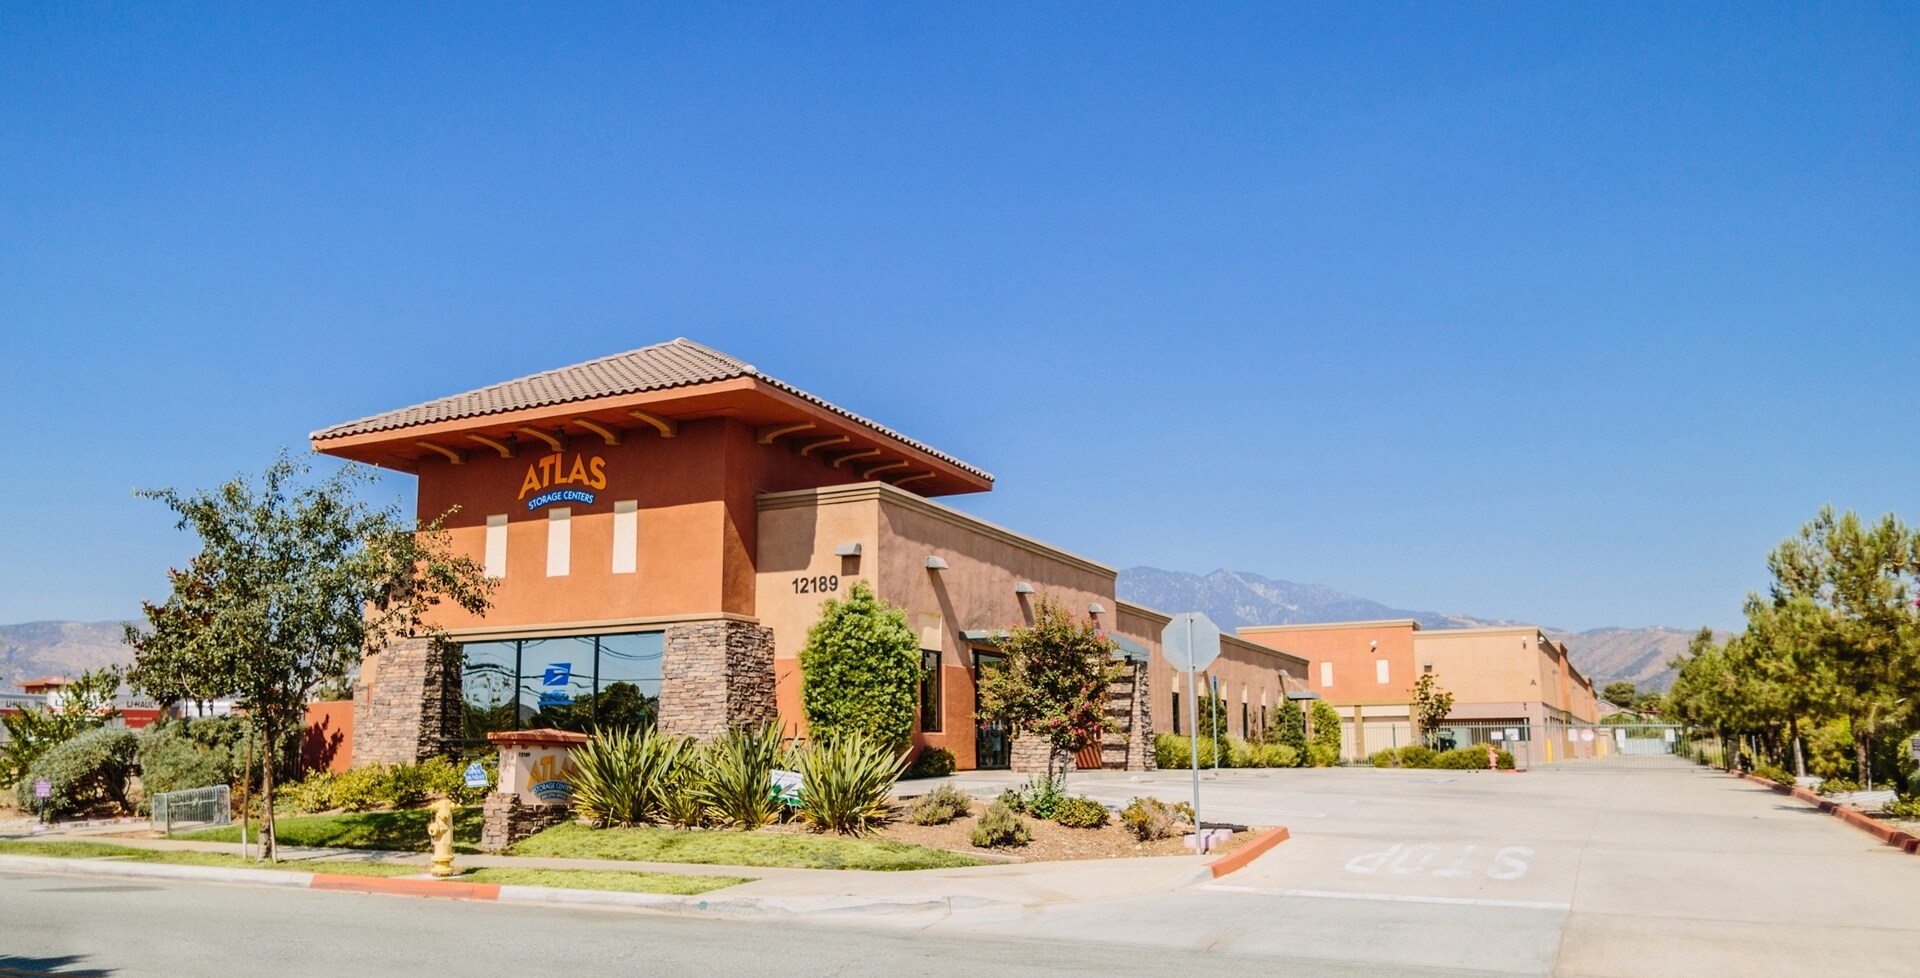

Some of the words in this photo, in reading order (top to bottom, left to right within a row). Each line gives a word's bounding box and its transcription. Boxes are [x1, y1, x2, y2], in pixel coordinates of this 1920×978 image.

[518, 453, 607, 500] ATLAS
[528, 491, 562, 510] STORAGE
[563, 490, 595, 504] CENTERS
[792, 575, 838, 594] 12189
[534, 782, 555, 794] STORAGE
[1345, 843, 1535, 880] STOP
